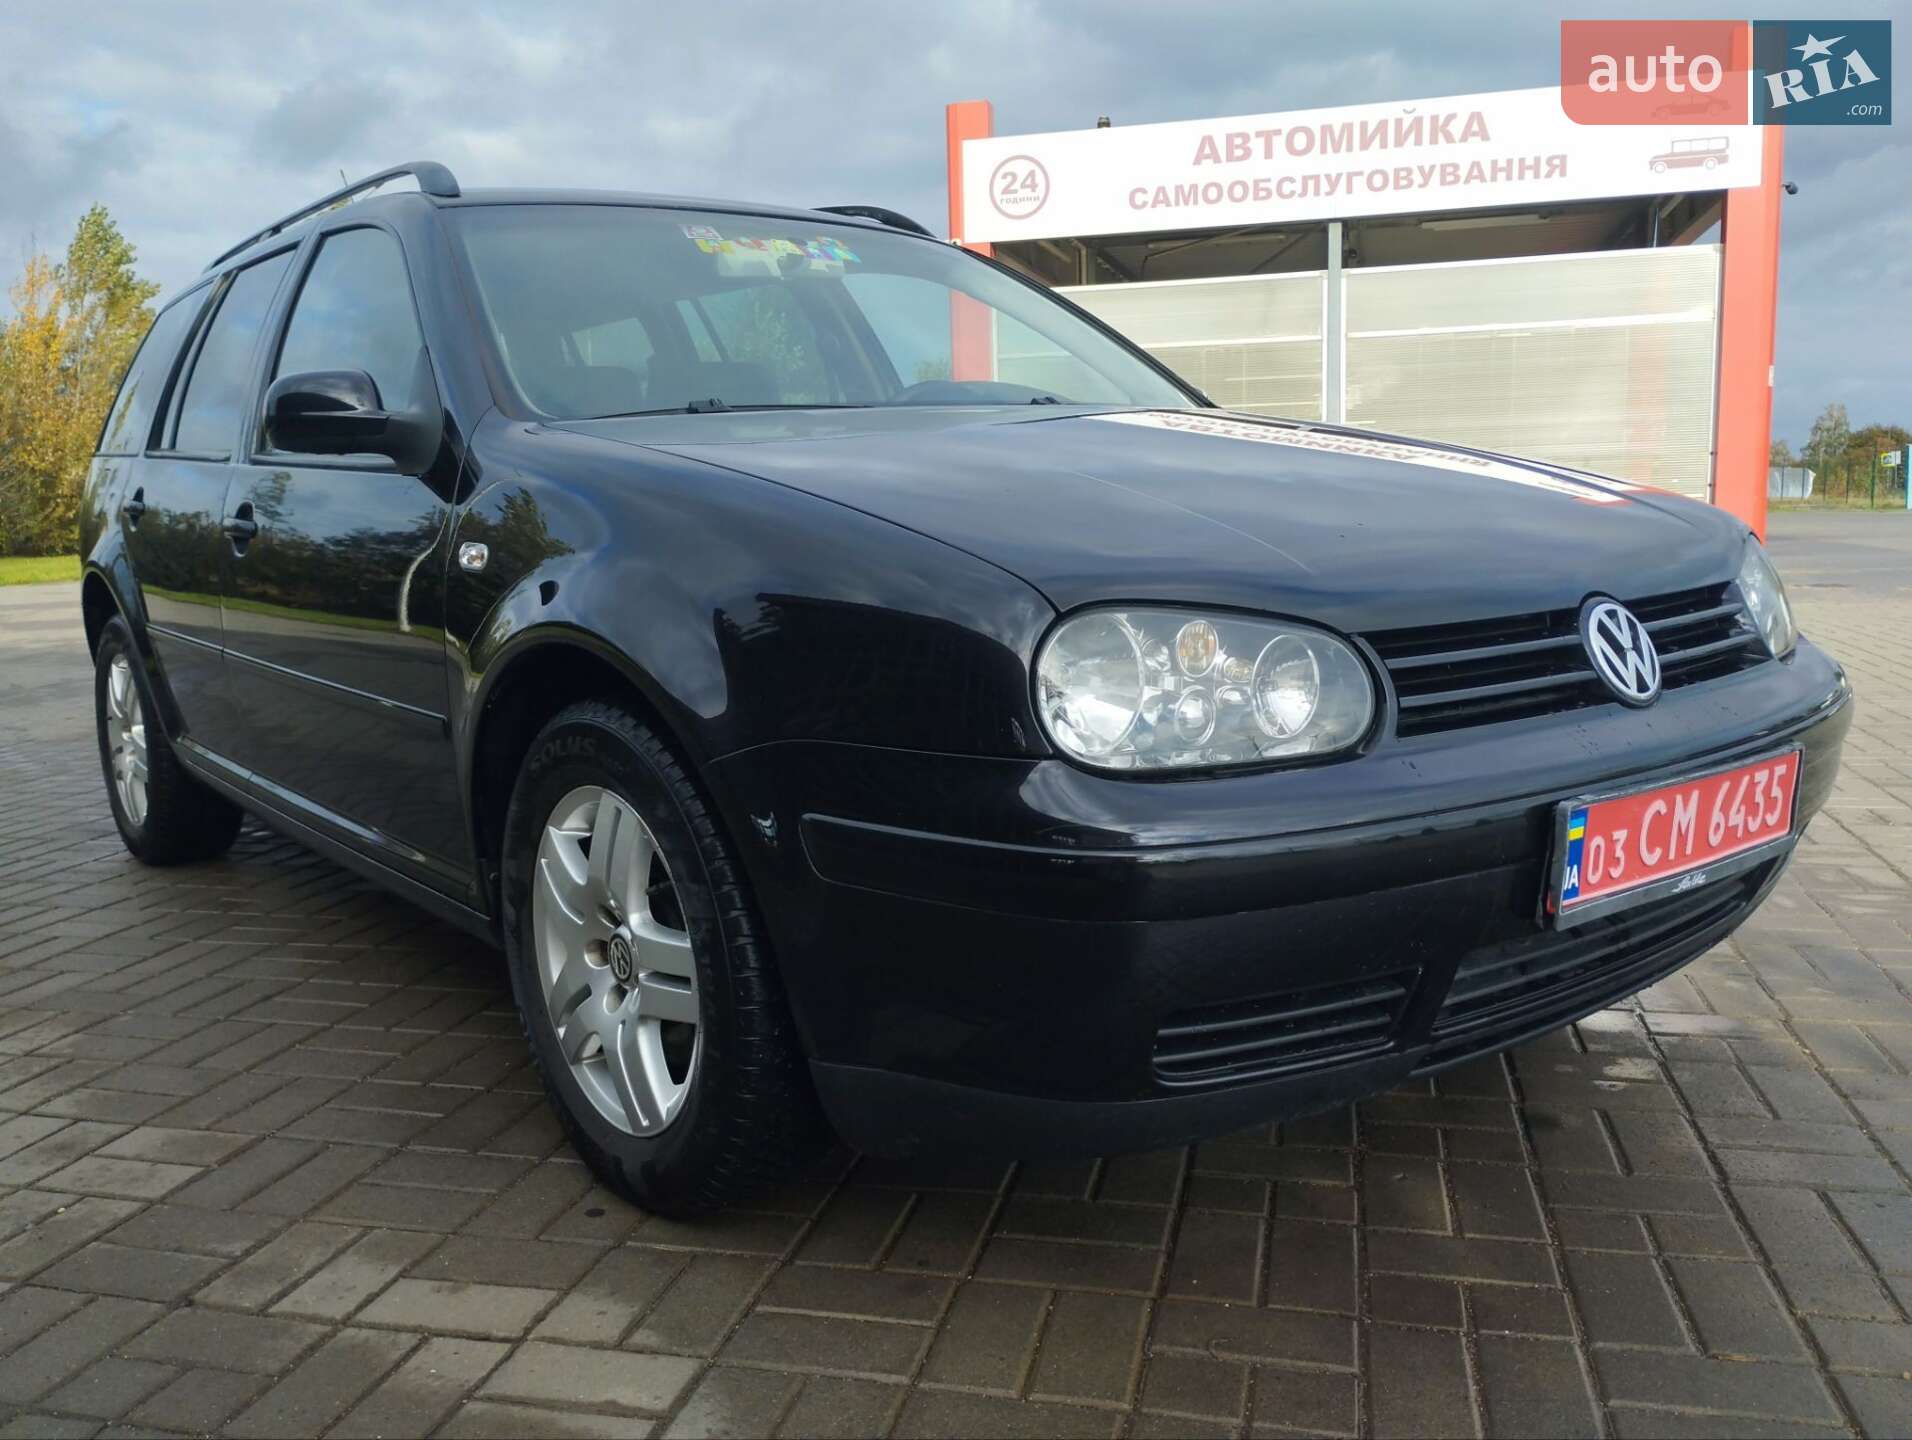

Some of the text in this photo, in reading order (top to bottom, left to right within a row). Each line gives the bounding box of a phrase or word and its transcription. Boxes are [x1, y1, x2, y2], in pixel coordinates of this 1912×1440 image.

[1192, 107, 1491, 167] АВТОМИЙКА
[1000, 169, 1039, 195] 24
[1128, 154, 1568, 211] САМООБСЛУГОВУВАННЯ
[1587, 763, 1788, 884] 03 CM 6435
